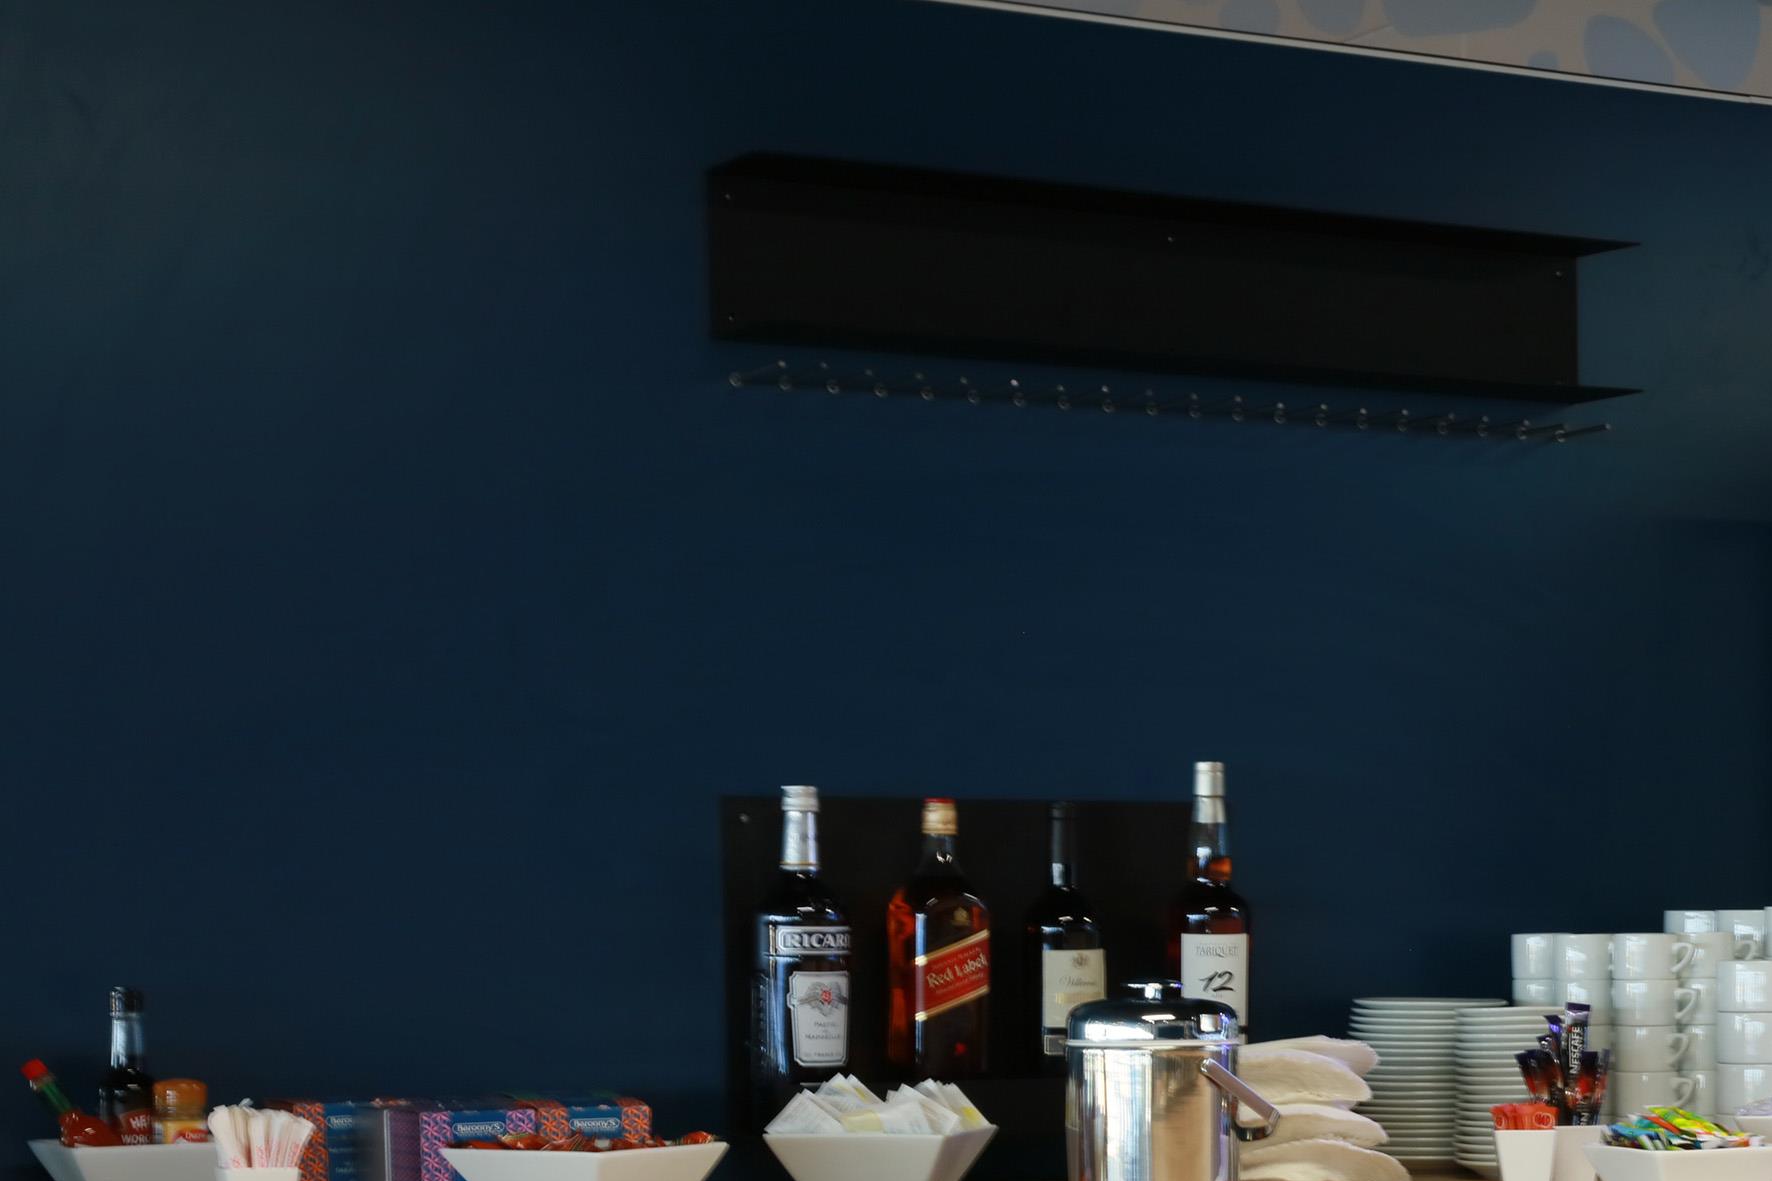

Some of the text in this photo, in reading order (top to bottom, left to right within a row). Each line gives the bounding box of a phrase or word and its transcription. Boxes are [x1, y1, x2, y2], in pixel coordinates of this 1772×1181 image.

[926, 966, 955, 988] Red
[954, 952, 988, 977] Label
[1199, 971, 1236, 992] 12
